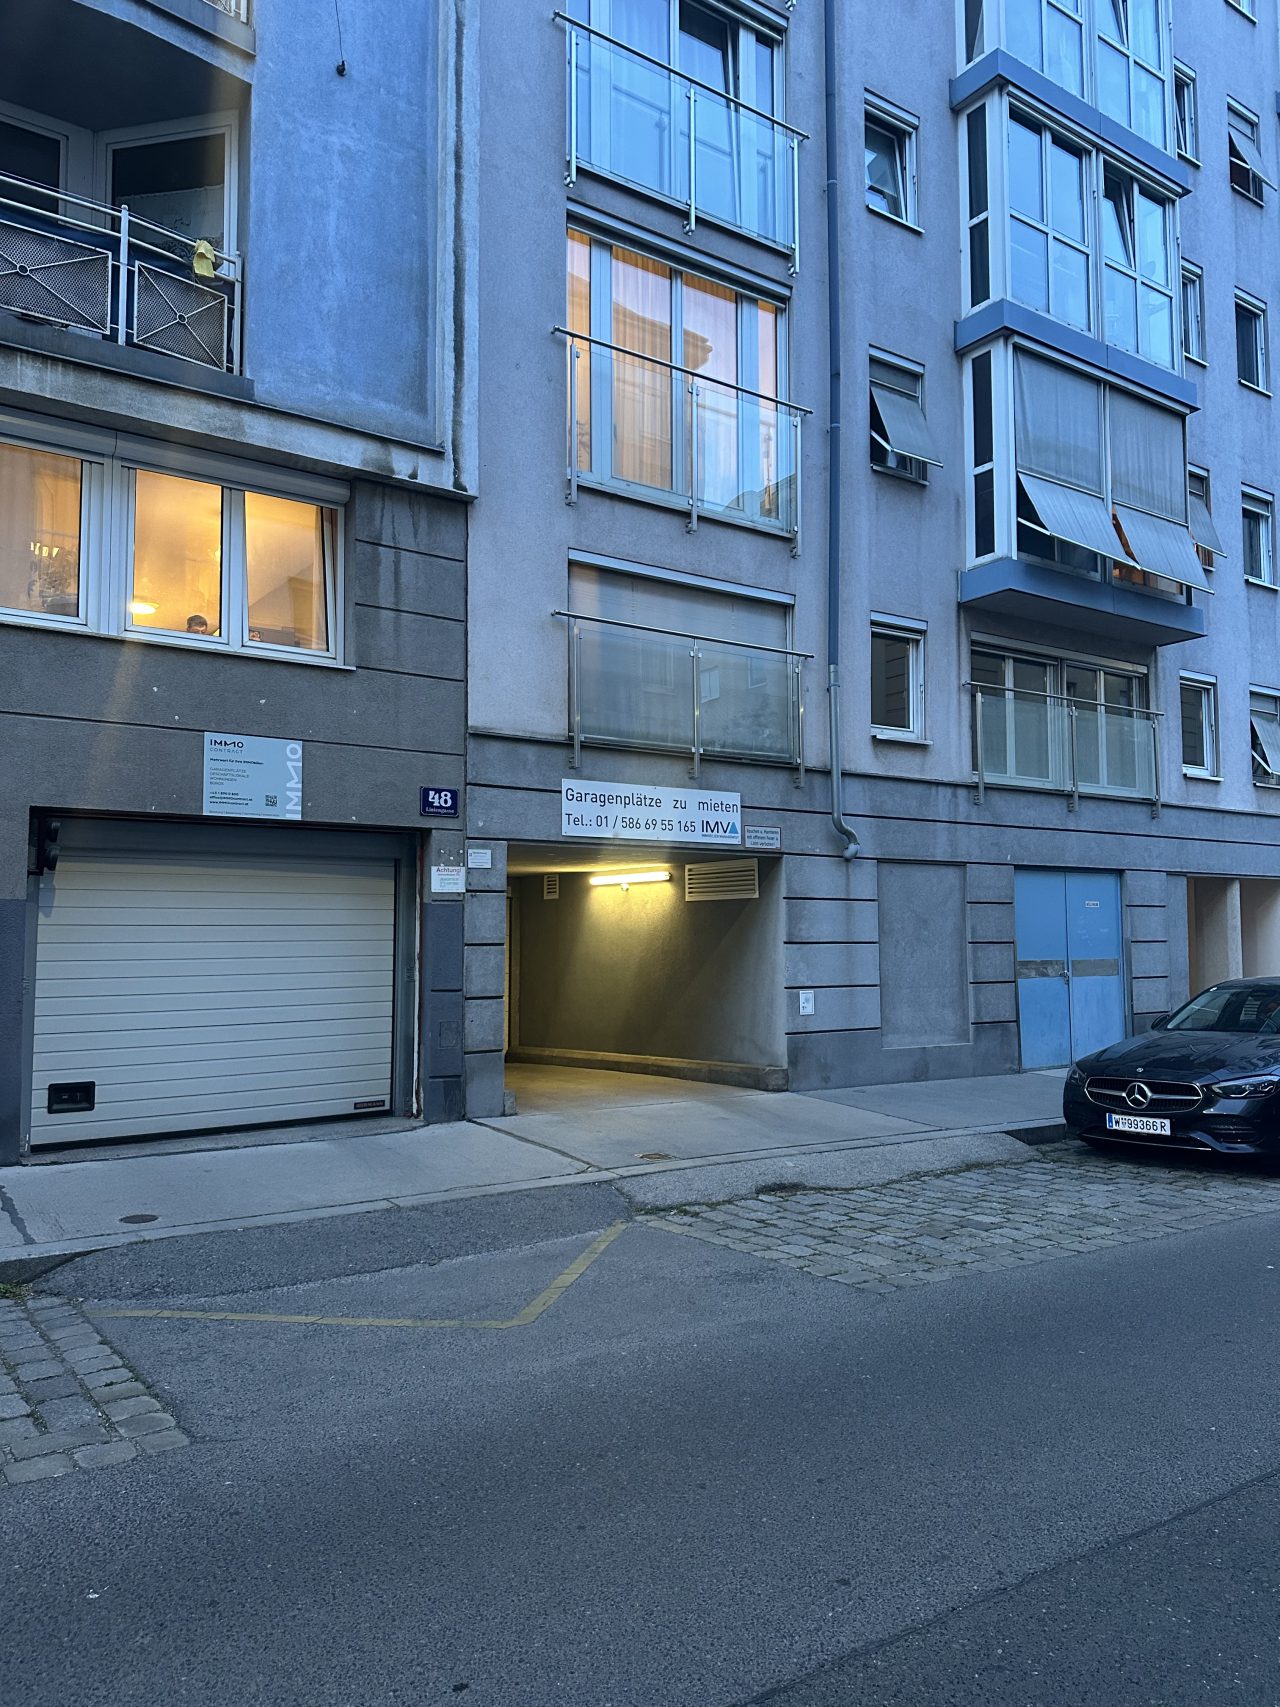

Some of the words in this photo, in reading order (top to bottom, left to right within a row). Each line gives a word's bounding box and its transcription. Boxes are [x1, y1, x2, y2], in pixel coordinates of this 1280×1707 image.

[210, 739, 244, 748] IMMO
[428, 790, 452, 807] 48
[565, 787, 662, 809] Garagenplätze
[673, 799, 687, 810] zu
[698, 798, 739, 813] mieten
[565, 813, 592, 827] Tel.:
[596, 815, 609, 828] 01
[612, 815, 619, 829] /
[621, 816, 642, 829] 586
[645, 818, 658, 830] 69
[661, 819, 674, 832] 55
[677, 820, 696, 833] 165
[1127, 1118, 1158, 1131] 99366
[1160, 1122, 1166, 1132] R
